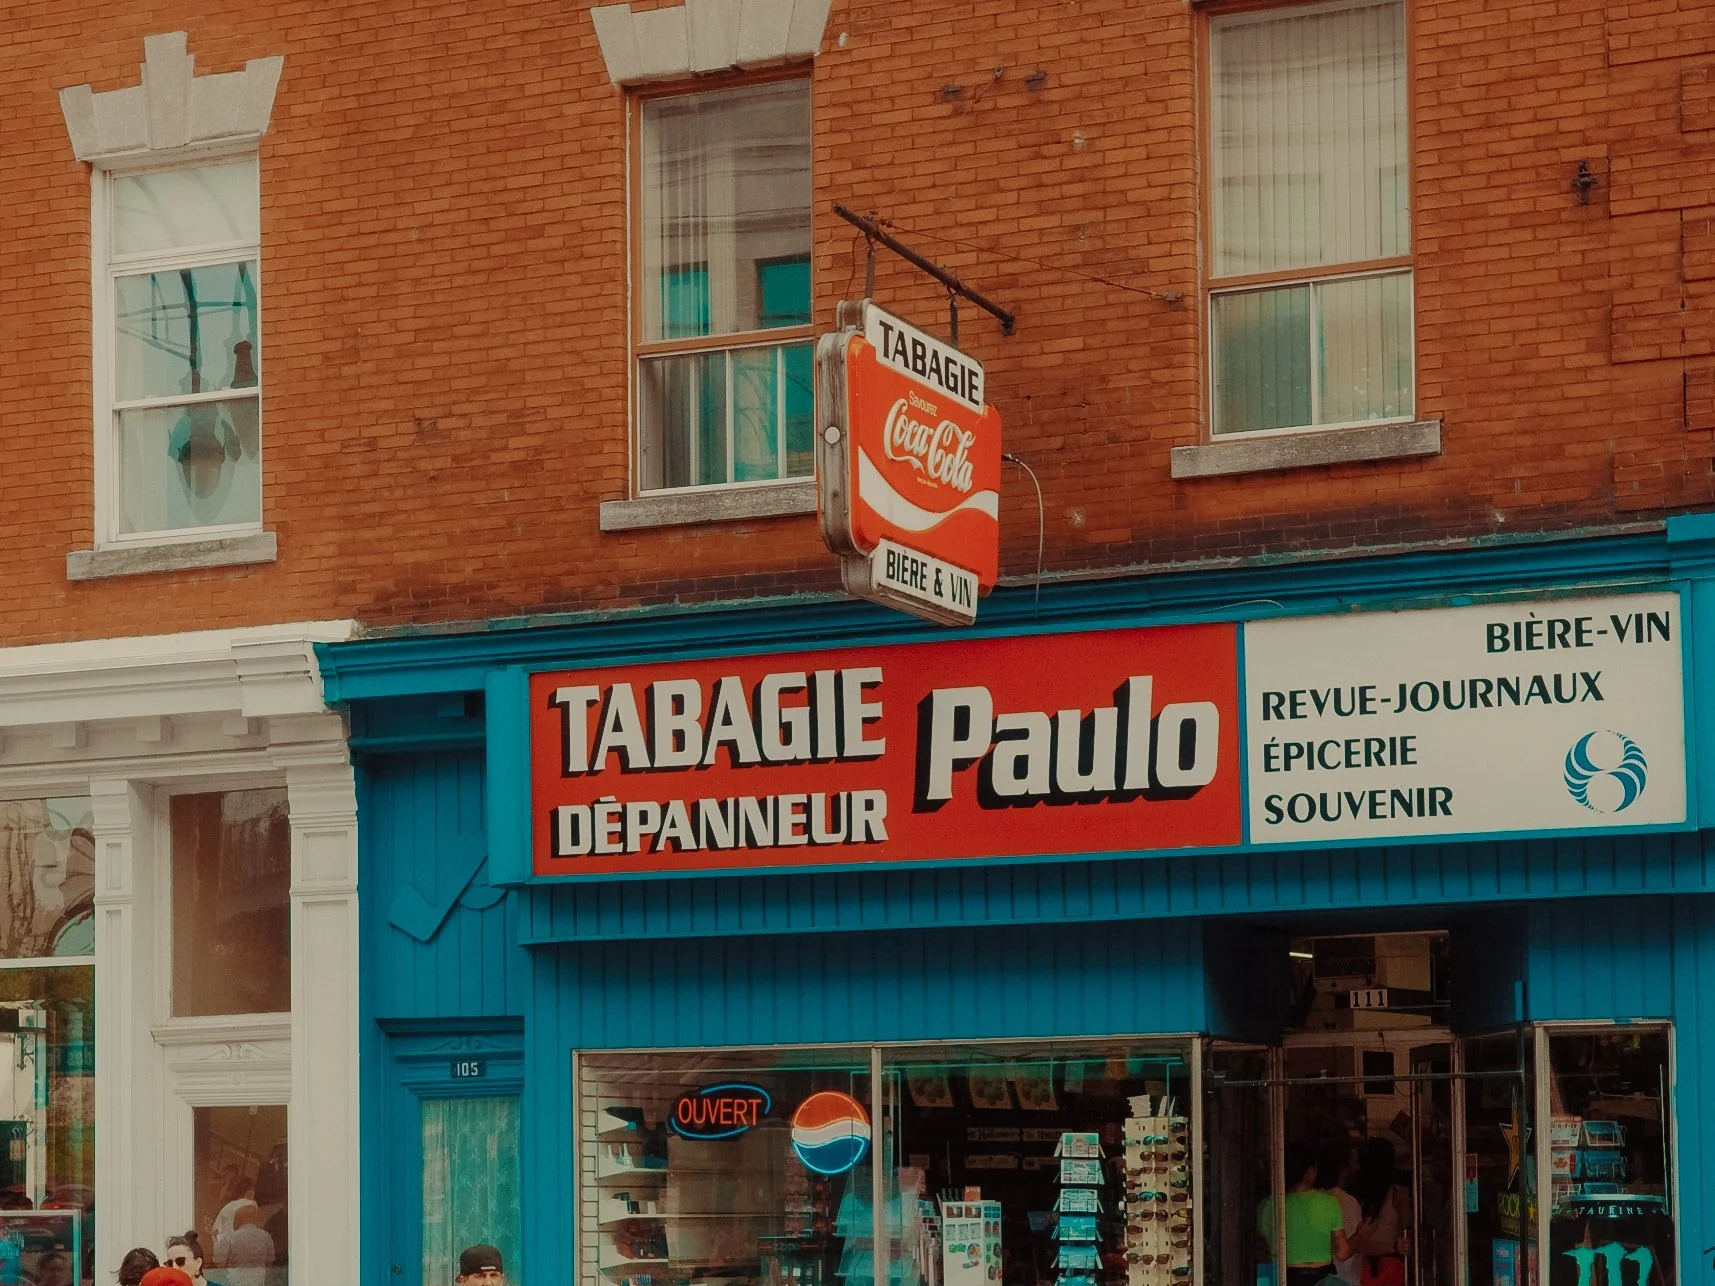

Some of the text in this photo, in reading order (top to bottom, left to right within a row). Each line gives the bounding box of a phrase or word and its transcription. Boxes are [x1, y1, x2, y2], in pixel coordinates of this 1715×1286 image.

[879, 320, 981, 406] TABAGIE
[908, 390, 939, 417] Savourez
[885, 547, 972, 609] BIÈRE & VIN
[1486, 610, 1671, 654] BIÈRE-VIN
[1262, 670, 1604, 721] REVUE-JOURNAUX
[553, 666, 887, 774] TABAGIE
[920, 674, 1220, 804] Paulo
[1263, 735, 1418, 773] ÉPICERIE
[556, 788, 890, 857] DÉPANNEUR
[1264, 786, 1454, 825] SOUVENIR
[1353, 990, 1385, 1008] 111
[456, 1062, 479, 1077] 105
[678, 1098, 762, 1126] OUVERT
[1579, 1205, 1644, 1217] TAURINE
